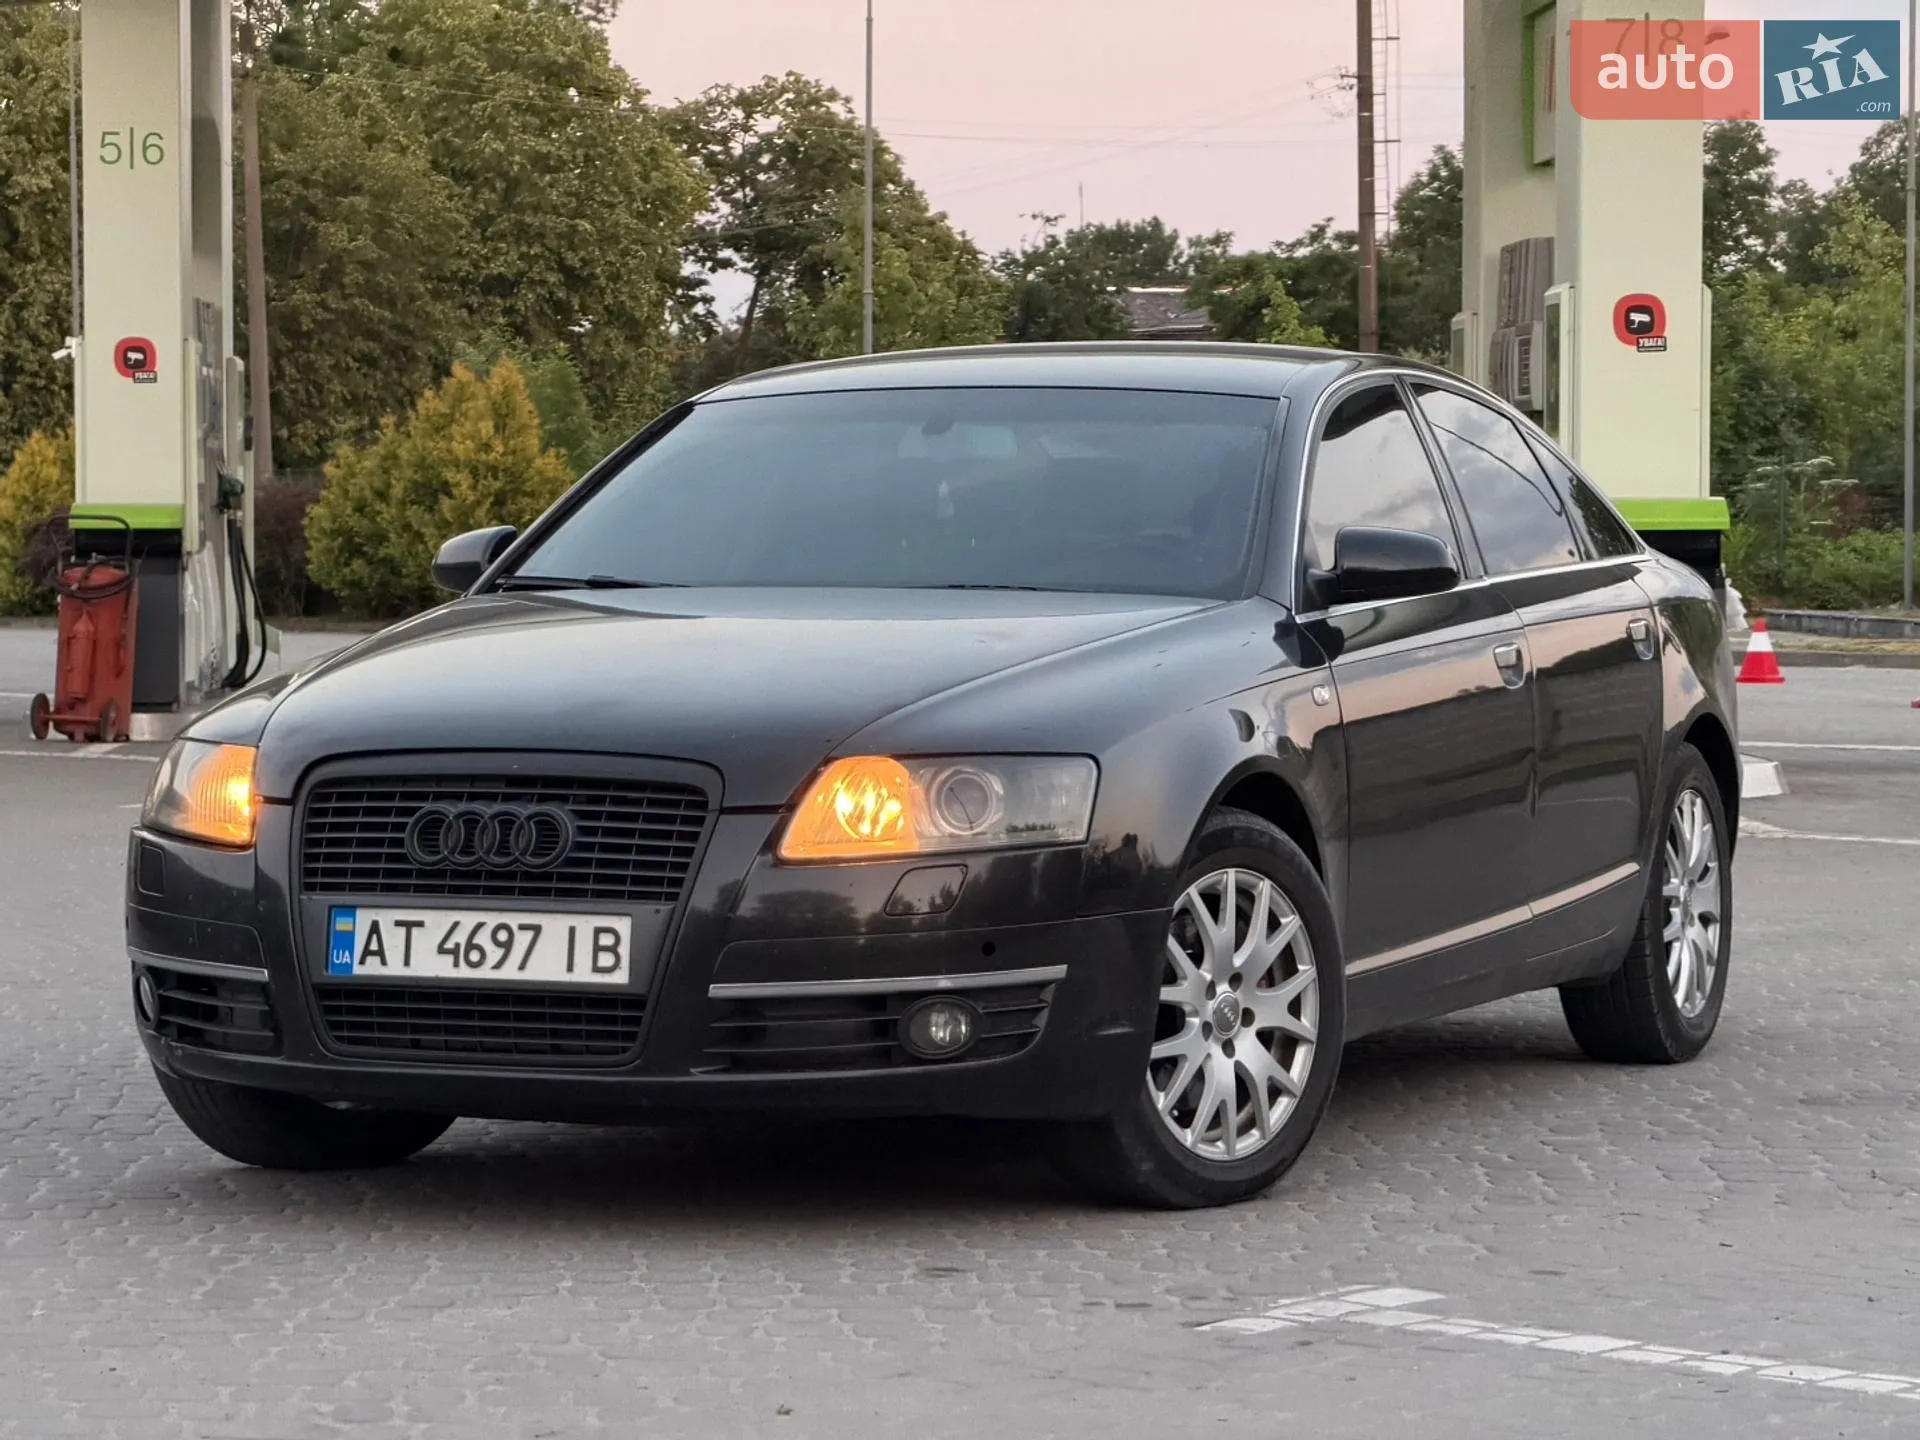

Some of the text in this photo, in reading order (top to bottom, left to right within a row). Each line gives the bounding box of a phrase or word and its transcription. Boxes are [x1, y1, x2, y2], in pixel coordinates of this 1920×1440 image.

[333, 949, 352, 965] UA
[359, 919, 622, 974] AT 4697 IB
